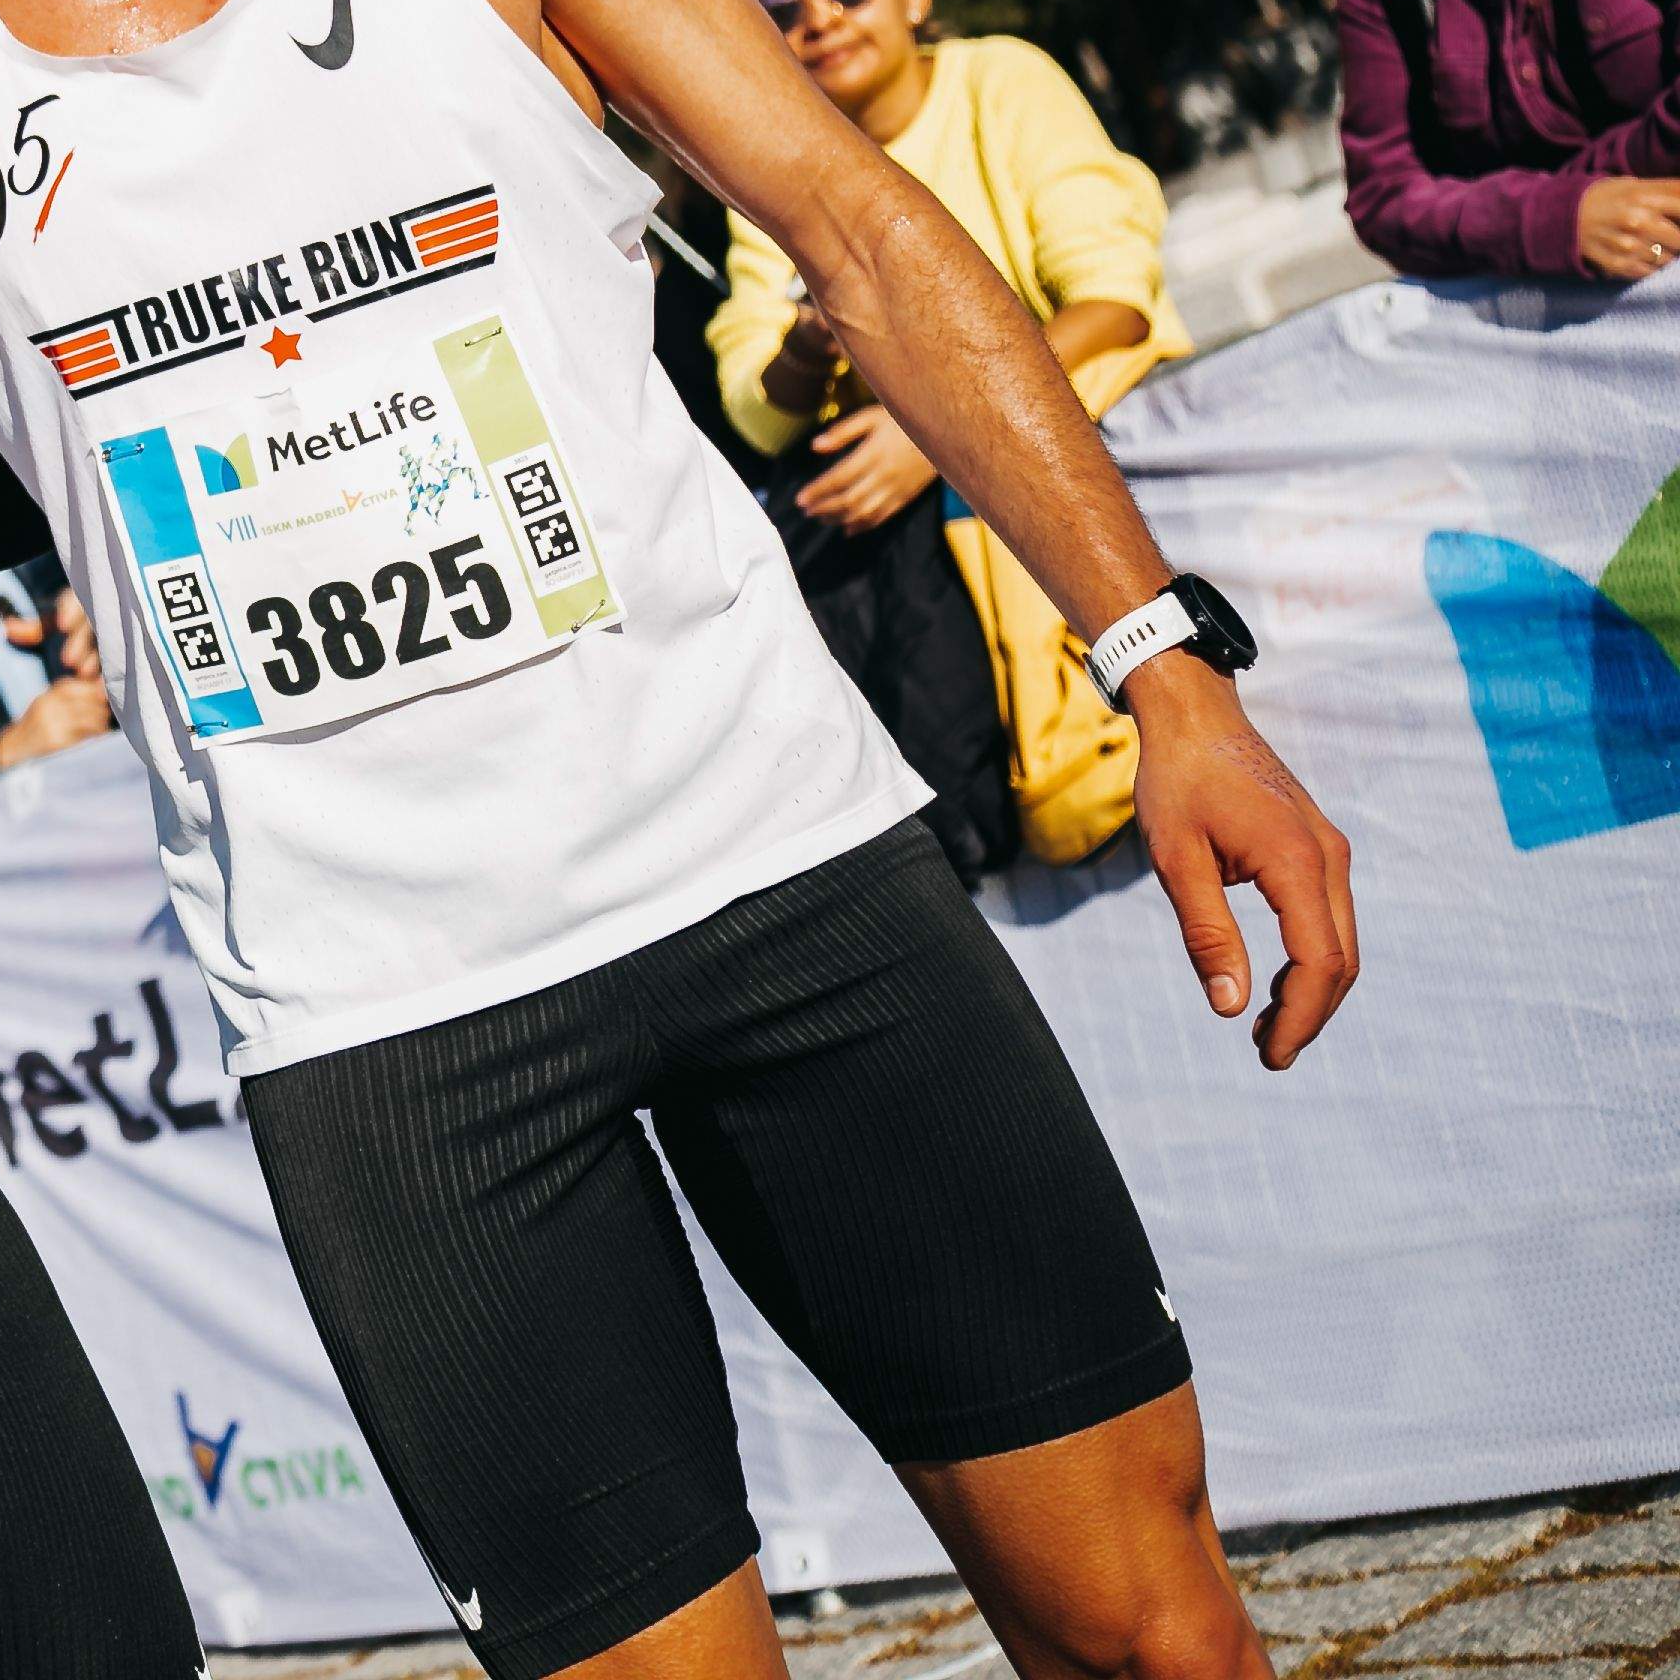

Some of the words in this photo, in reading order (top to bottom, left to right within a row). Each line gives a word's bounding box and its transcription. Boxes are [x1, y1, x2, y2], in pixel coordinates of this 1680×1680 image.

[107, 254, 301, 365] TRUEKE
[300, 217, 419, 304] RUN
[265, 391, 438, 472] MetLife
[216, 514, 258, 544] VIII
[261, 522, 294, 537] 15KM
[246, 533, 513, 697] 3825
